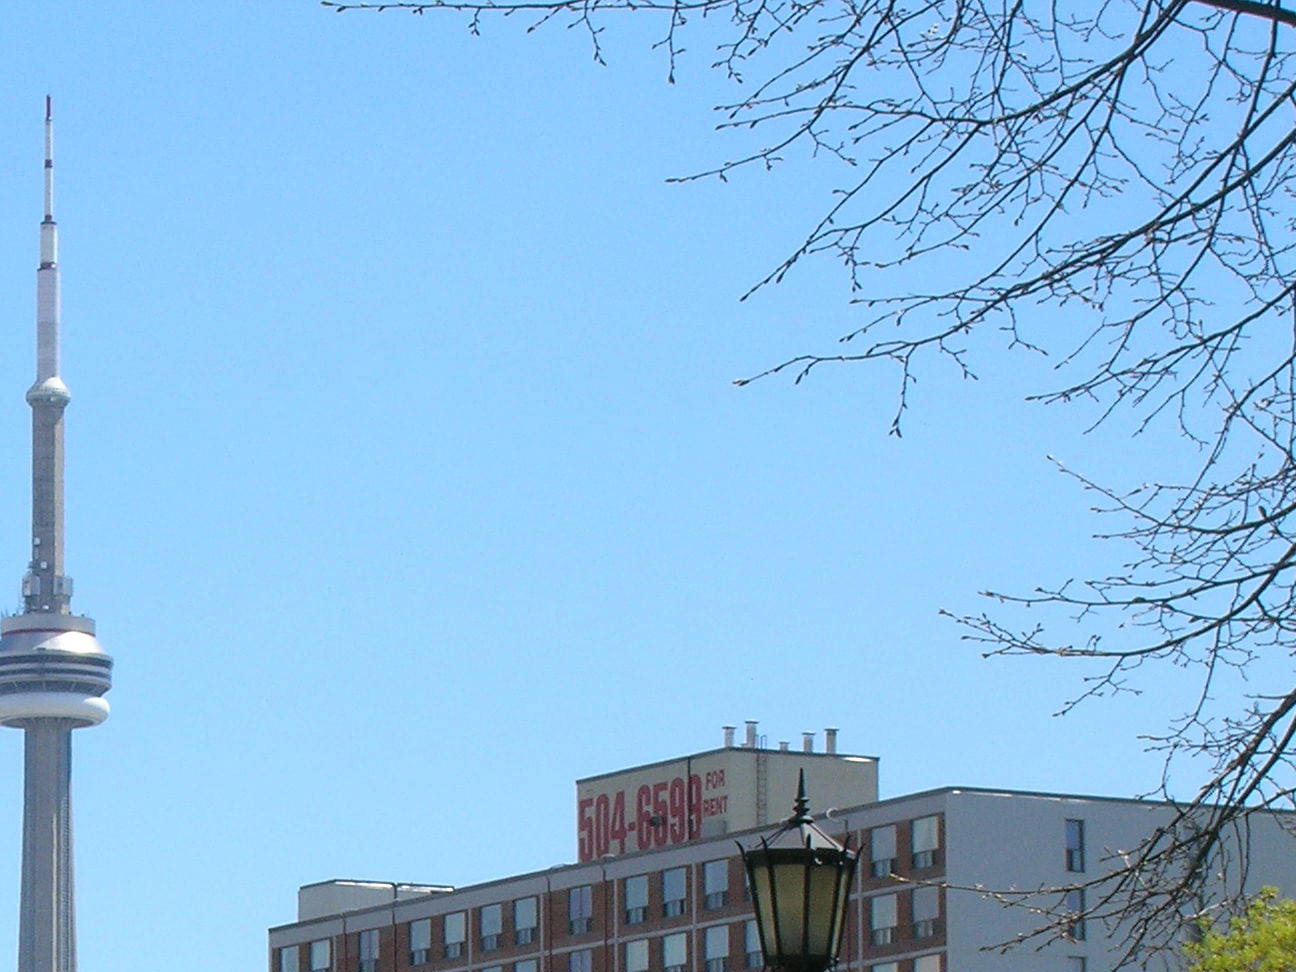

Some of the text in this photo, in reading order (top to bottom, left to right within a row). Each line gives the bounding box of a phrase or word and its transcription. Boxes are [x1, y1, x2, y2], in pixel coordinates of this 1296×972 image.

[705, 769, 725, 791] FOR
[703, 795, 728, 817] RENT
[579, 774, 702, 864] 504-6599
